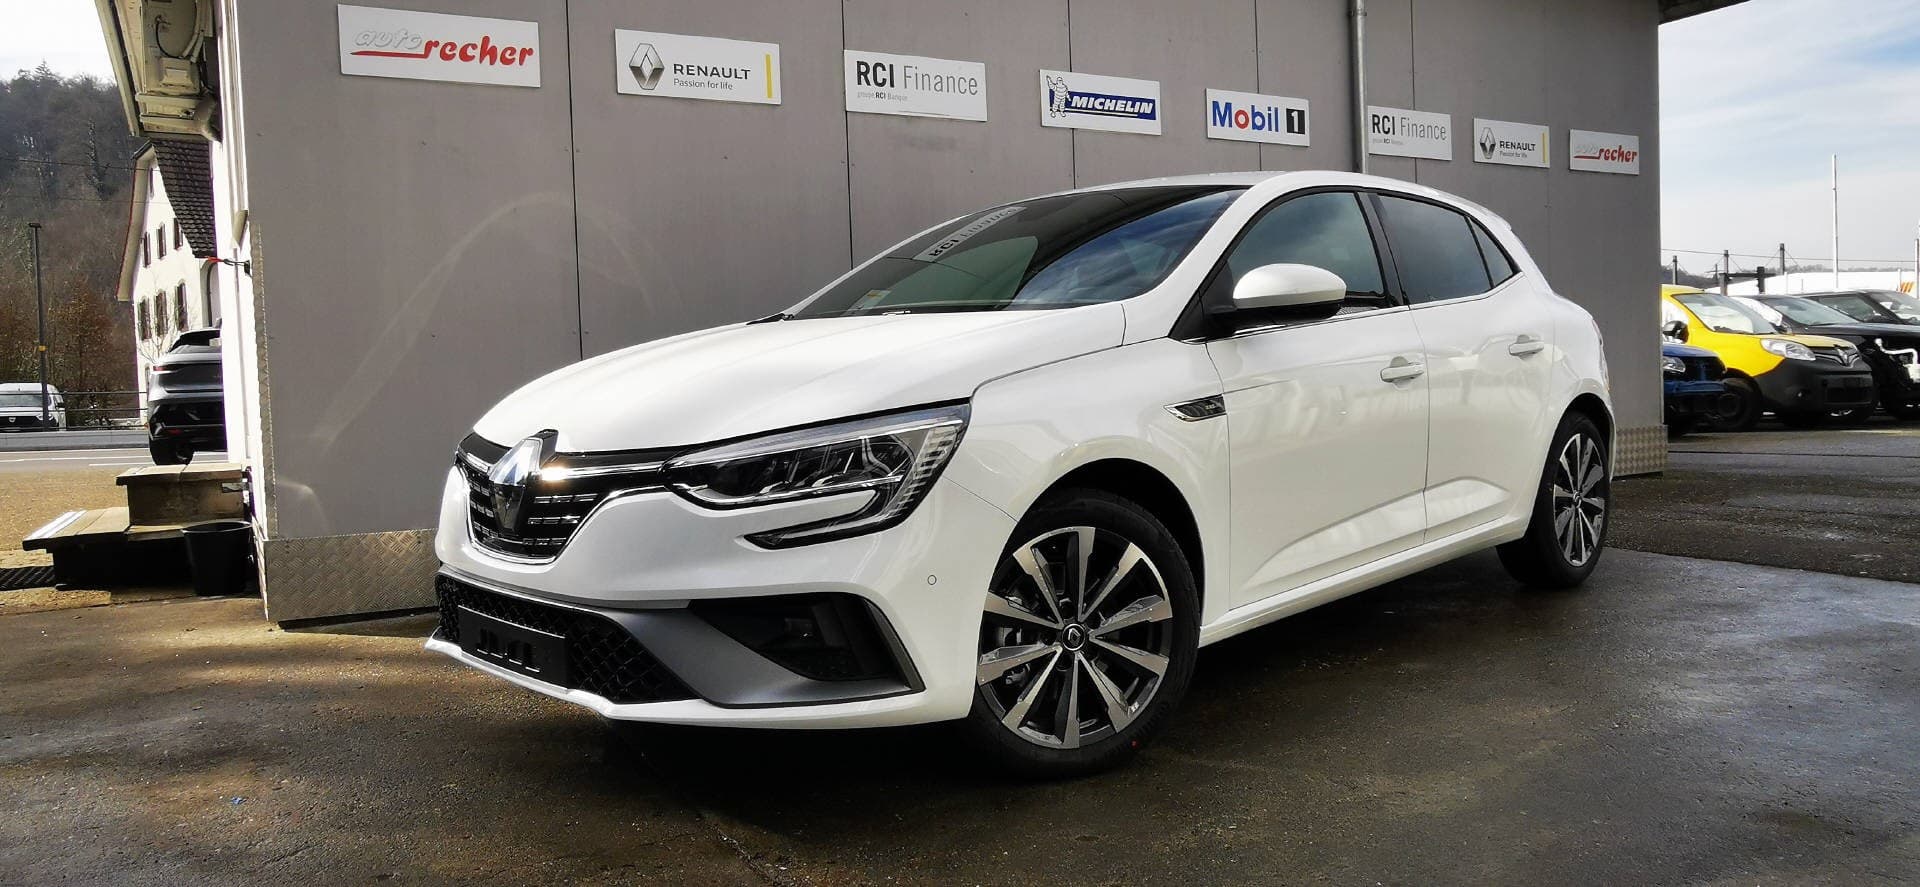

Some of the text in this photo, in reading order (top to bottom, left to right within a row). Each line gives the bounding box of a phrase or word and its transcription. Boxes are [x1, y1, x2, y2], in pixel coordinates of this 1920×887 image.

[423, 35, 534, 66] recher
[673, 63, 751, 80] RENAULT
[856, 60, 978, 95] RCI Finance
[673, 78, 733, 90] Passion for life
[875, 91, 886, 99] RCI
[1071, 95, 1154, 114] MICHELIN
[1212, 100, 1279, 132] Mobil
[1372, 113, 1447, 140] RCI Finance
[1499, 140, 1536, 151] RENAULT
